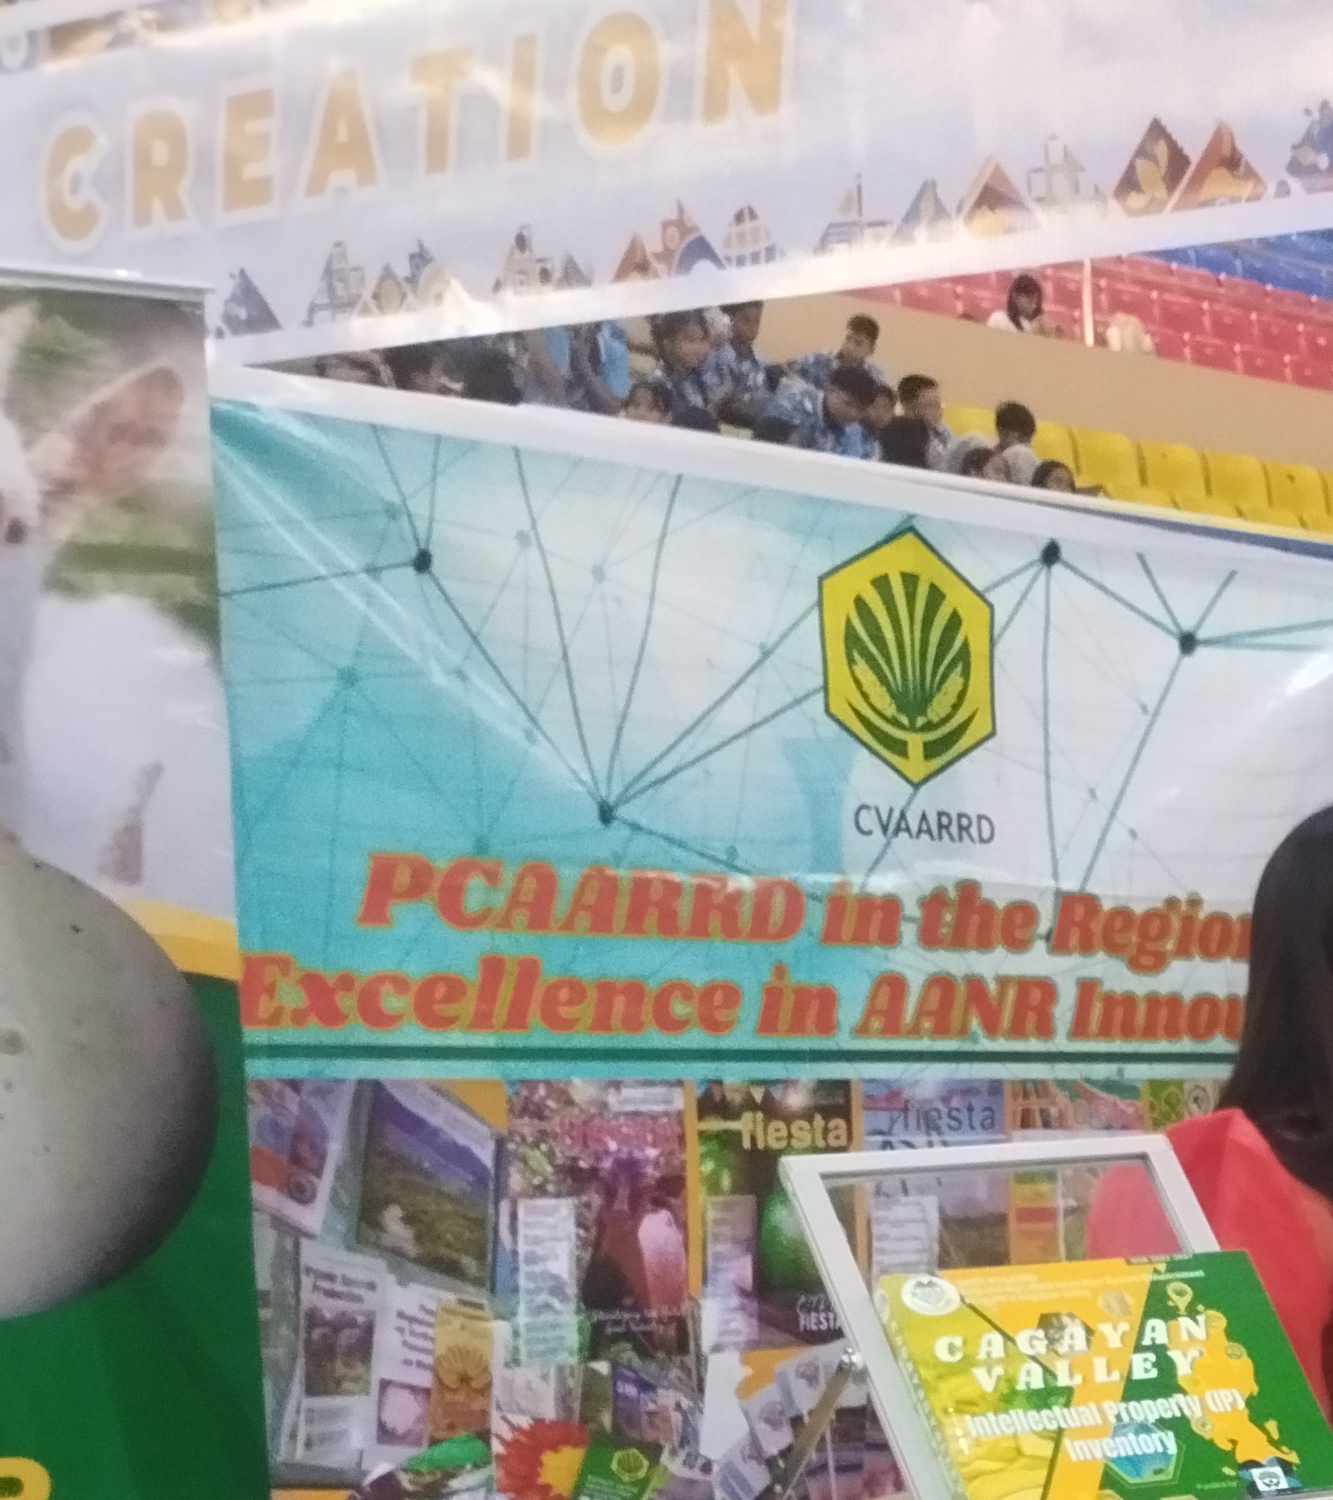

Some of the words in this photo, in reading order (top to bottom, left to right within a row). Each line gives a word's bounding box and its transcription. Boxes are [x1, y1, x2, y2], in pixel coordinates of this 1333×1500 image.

[41, 0, 791, 245] CREATION
[852, 803, 998, 848] CVAARRD
[355, 850, 805, 941] PCAARRD
[820, 867, 913, 948] in
[919, 877, 1040, 956] the
[236, 949, 746, 1037] Excellence
[755, 962, 846, 1041] in
[852, 972, 1057, 1043] AANR
[739, 1111, 850, 1152] fiesta
[932, 1313, 1208, 1365] CAGAYAN
[972, 1349, 1202, 1393] VALLEY
[964, 1400, 1102, 1439] Intellectual
[1101, 1391, 1203, 1429] Property
[1064, 1430, 1179, 1463] Inventory
